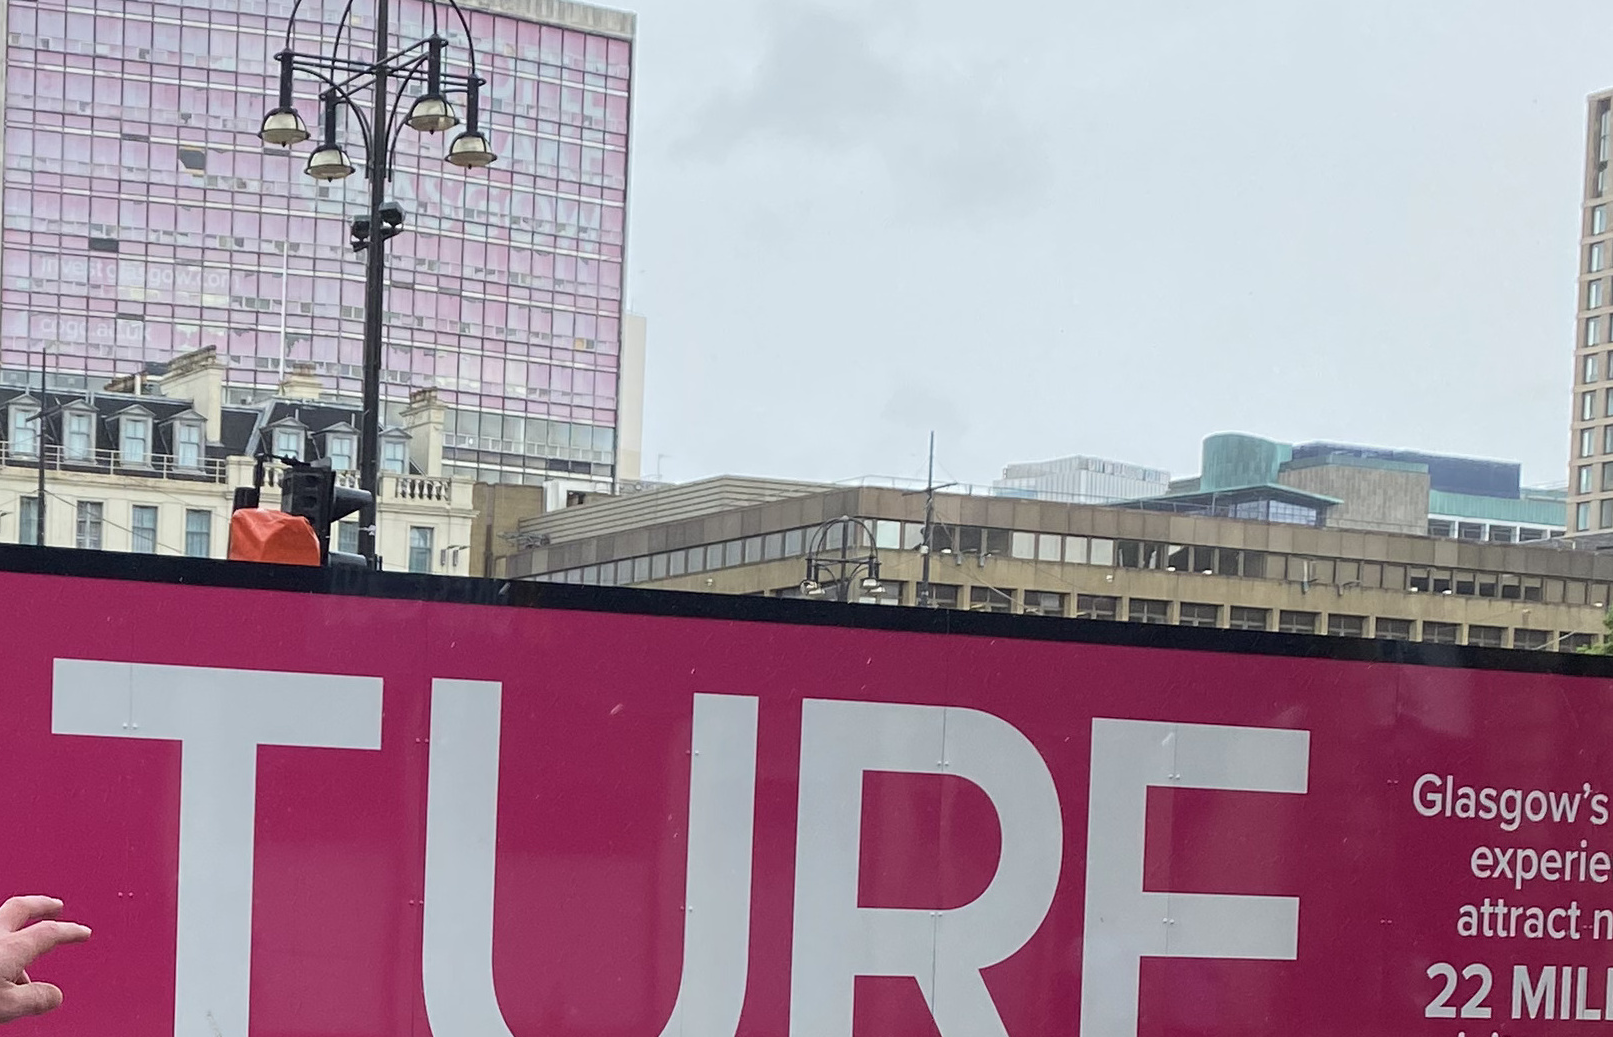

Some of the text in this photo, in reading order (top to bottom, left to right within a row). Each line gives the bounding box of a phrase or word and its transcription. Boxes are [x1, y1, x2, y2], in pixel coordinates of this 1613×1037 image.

[1412, 772, 1610, 832] Glasgow's
[1470, 839, 1613, 890] experie
[1456, 897, 1582, 941] attract
[1424, 962, 1493, 1019] 22
